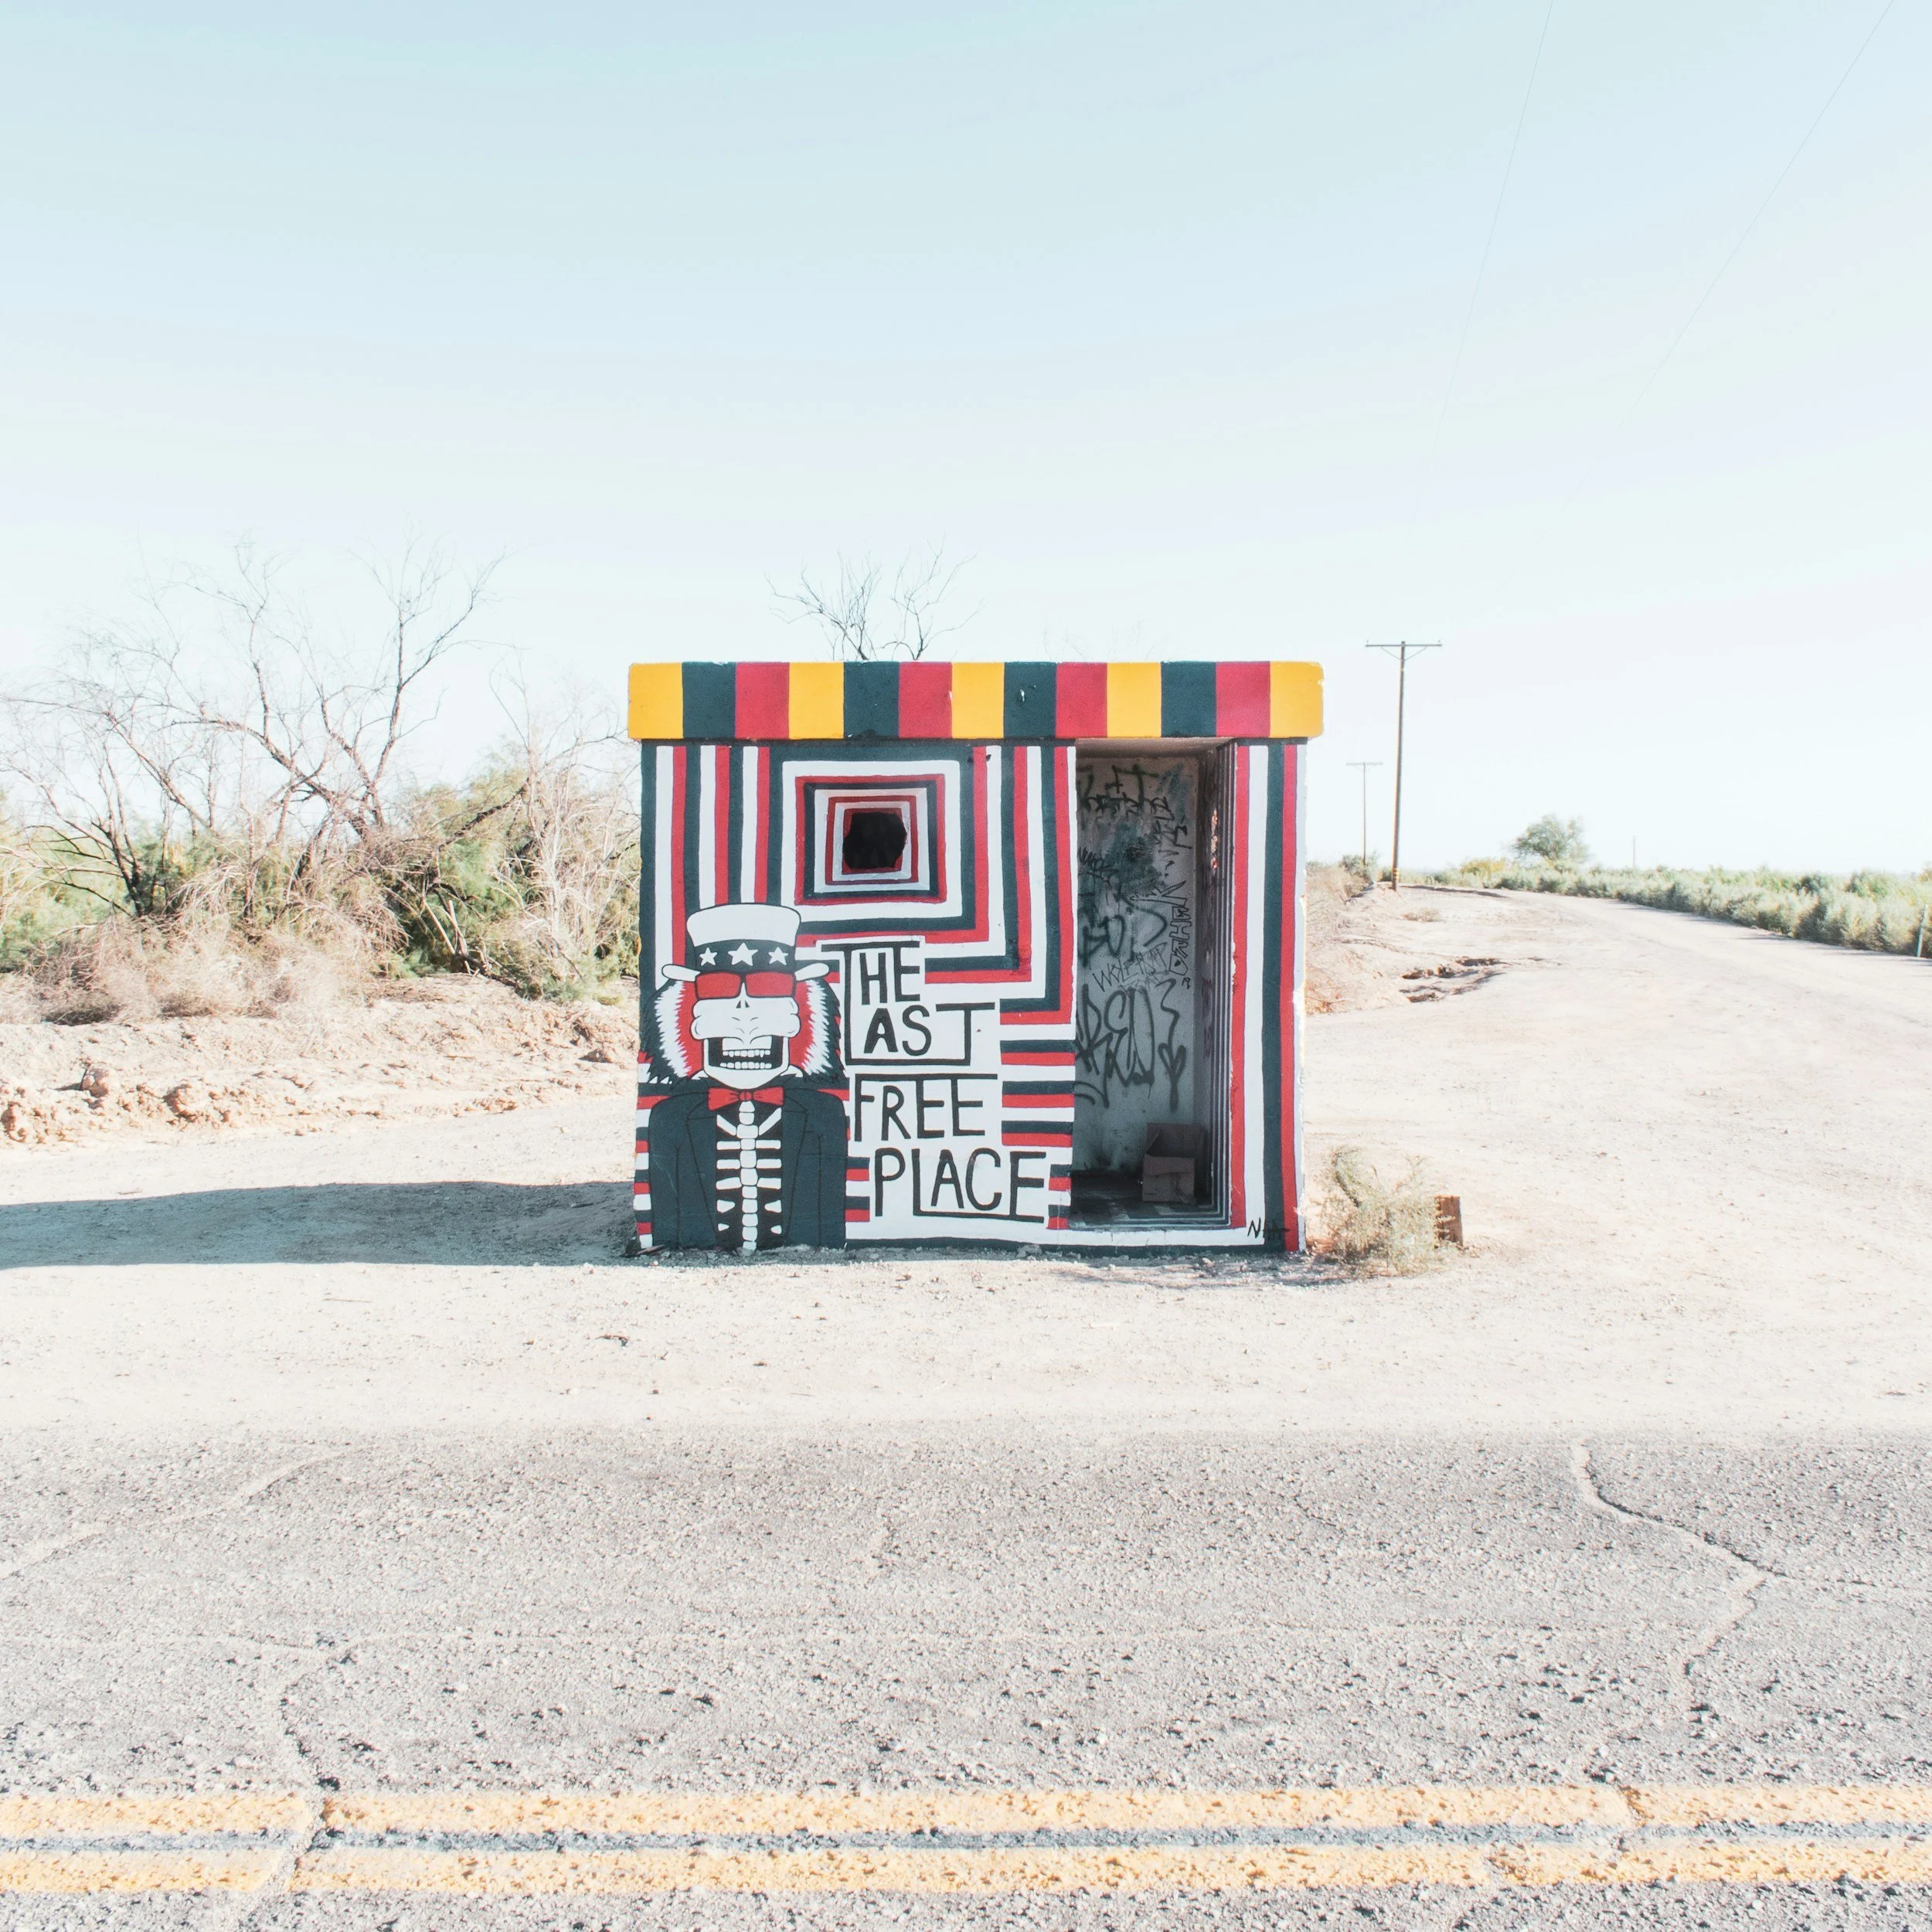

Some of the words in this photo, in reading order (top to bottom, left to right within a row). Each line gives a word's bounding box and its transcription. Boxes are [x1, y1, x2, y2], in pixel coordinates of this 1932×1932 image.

[821, 940, 920, 1005] THE
[853, 1073, 998, 1142] FREE
[874, 1147, 1047, 1223] PLACE
